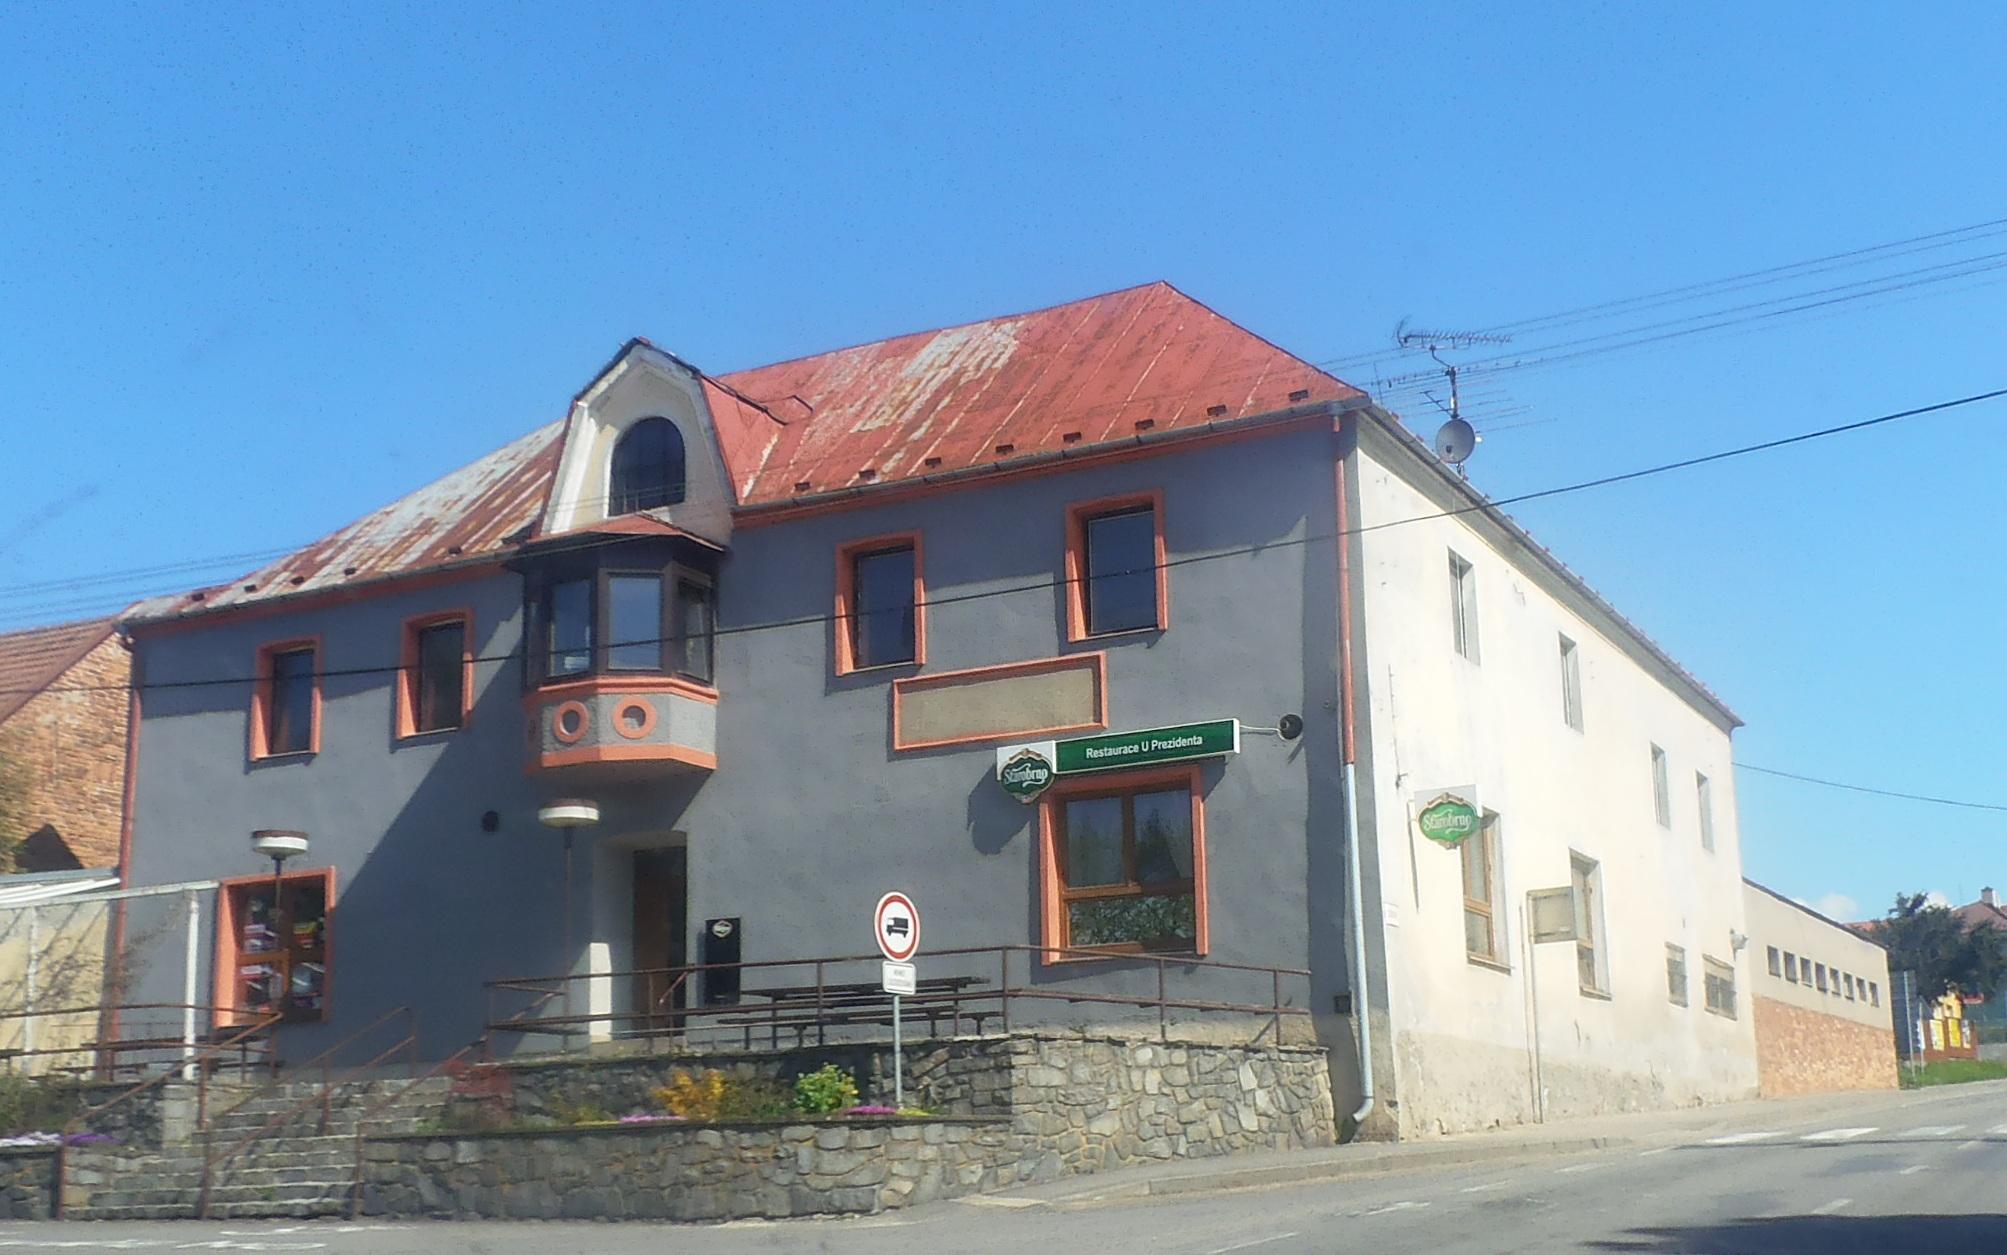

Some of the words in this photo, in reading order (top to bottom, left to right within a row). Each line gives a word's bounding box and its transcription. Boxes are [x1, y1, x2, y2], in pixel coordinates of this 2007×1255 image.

[1086, 744, 1139, 759] Restaurace
[1141, 740, 1149, 752] U
[1151, 735, 1203, 751] Prezidenta
